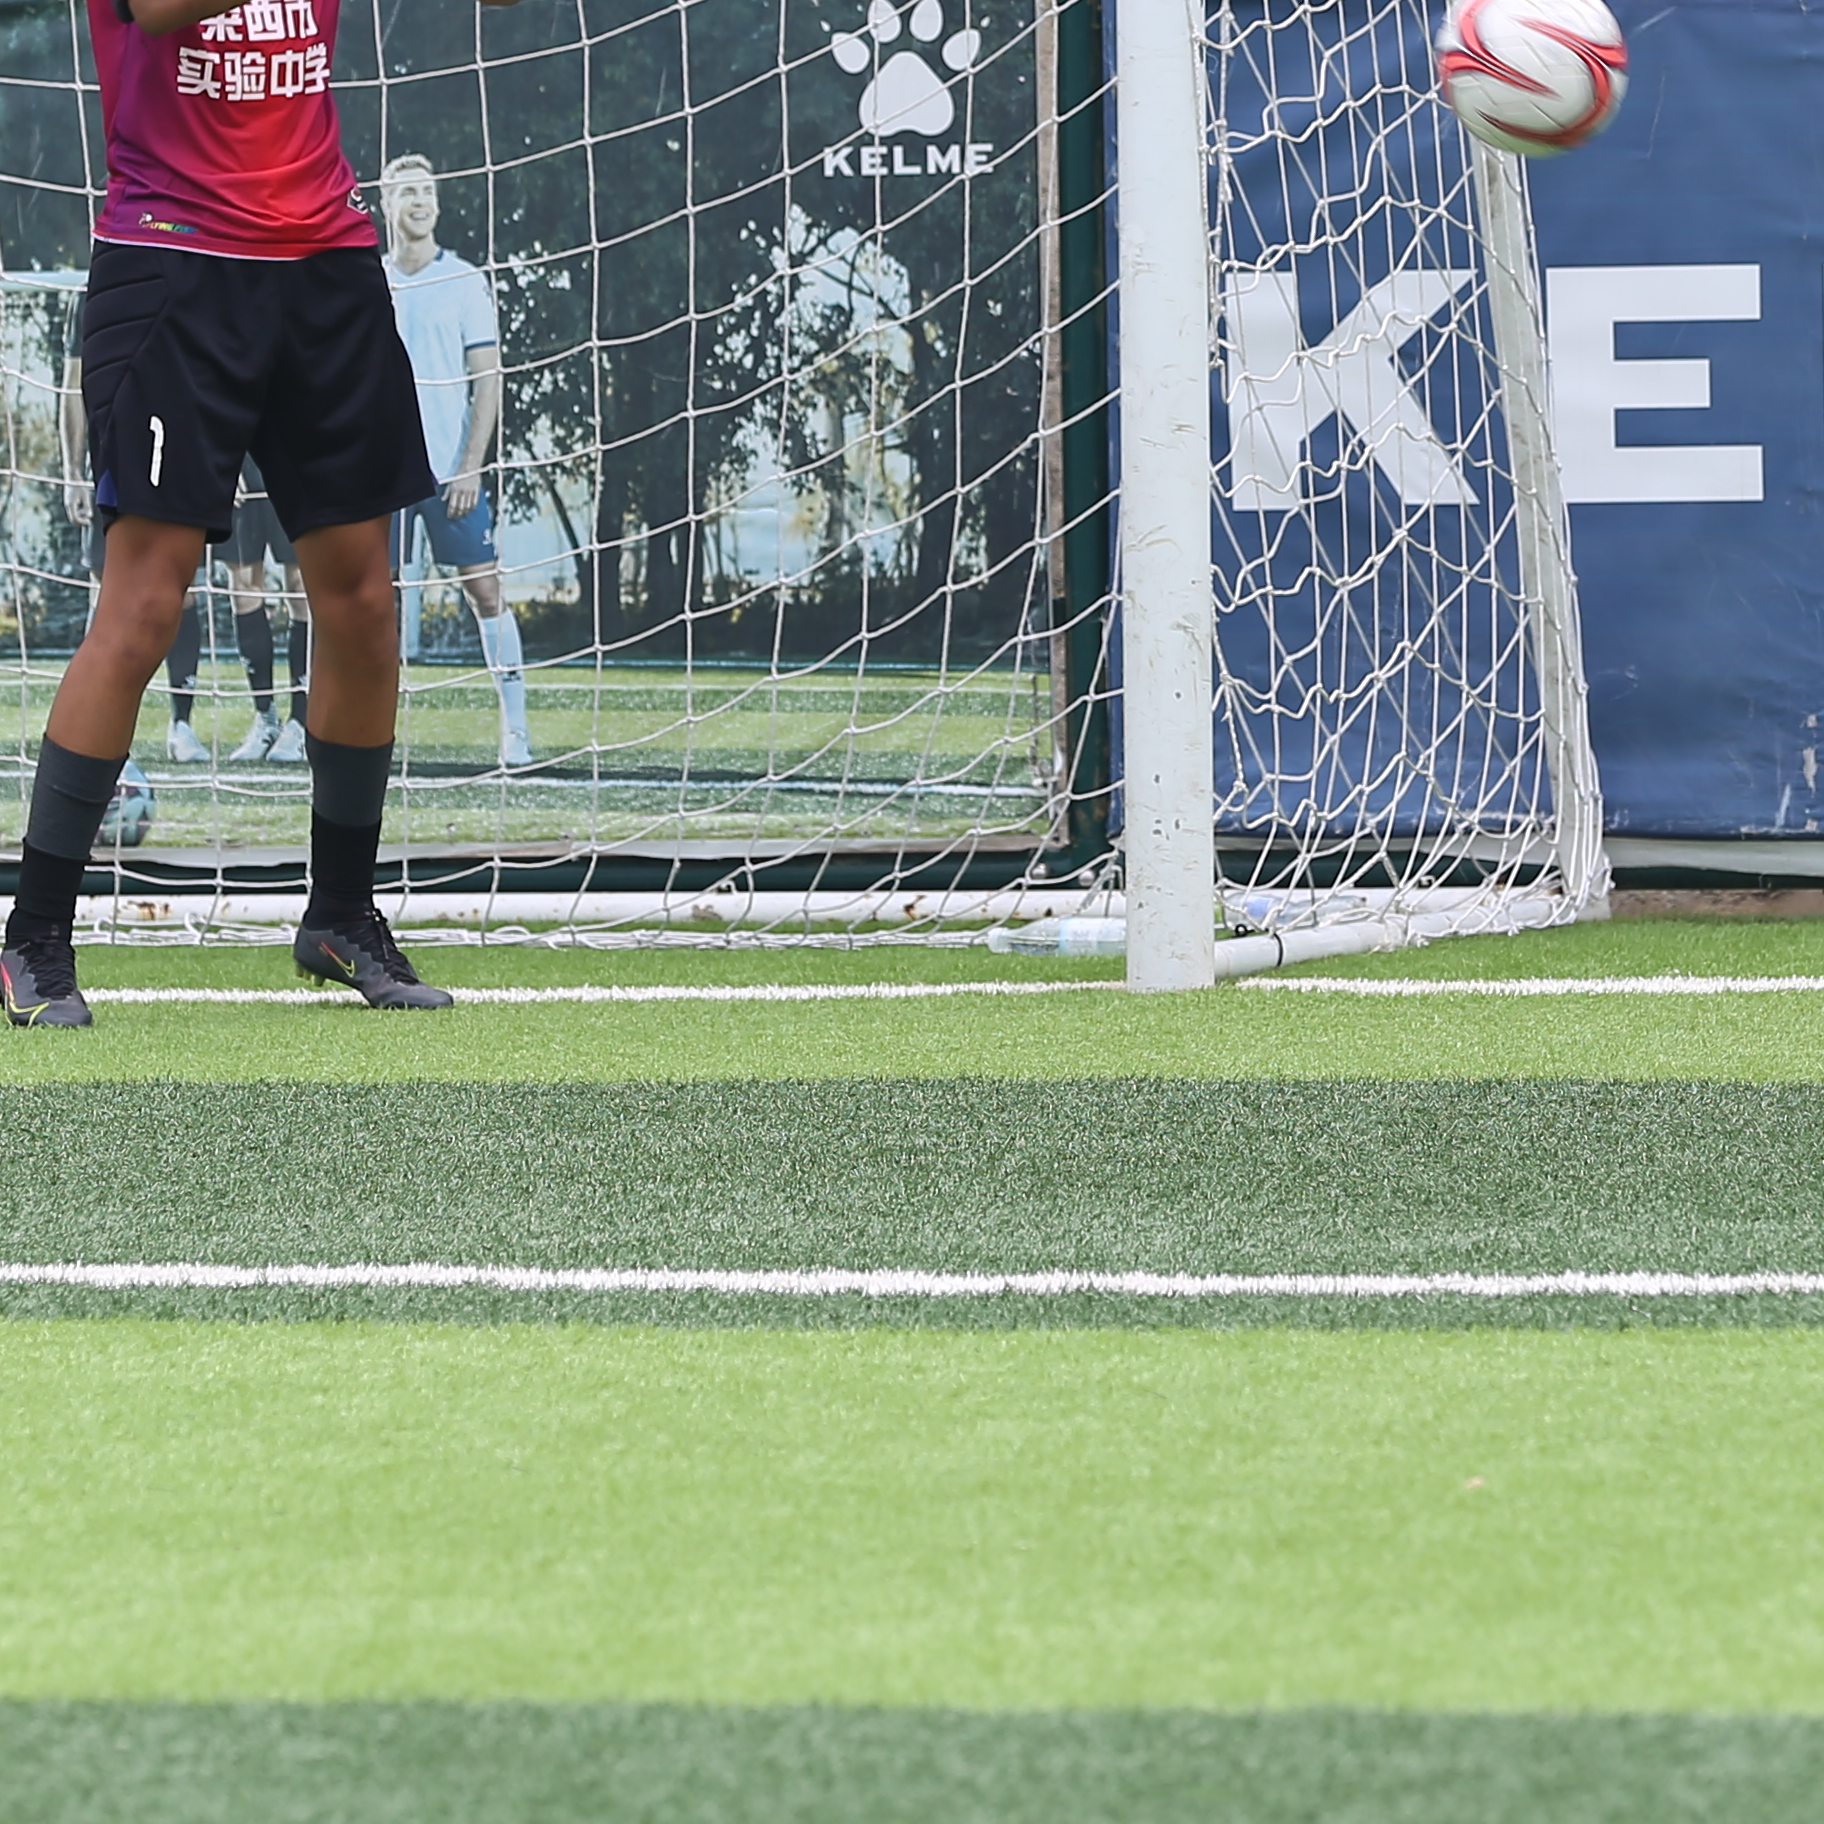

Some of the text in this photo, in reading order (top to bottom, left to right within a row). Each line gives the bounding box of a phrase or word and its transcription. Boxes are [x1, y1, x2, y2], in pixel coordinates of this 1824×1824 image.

[176, 42, 331, 102] 实验中学
[823, 142, 995, 178] KELME
[149, 415, 165, 487] 1
